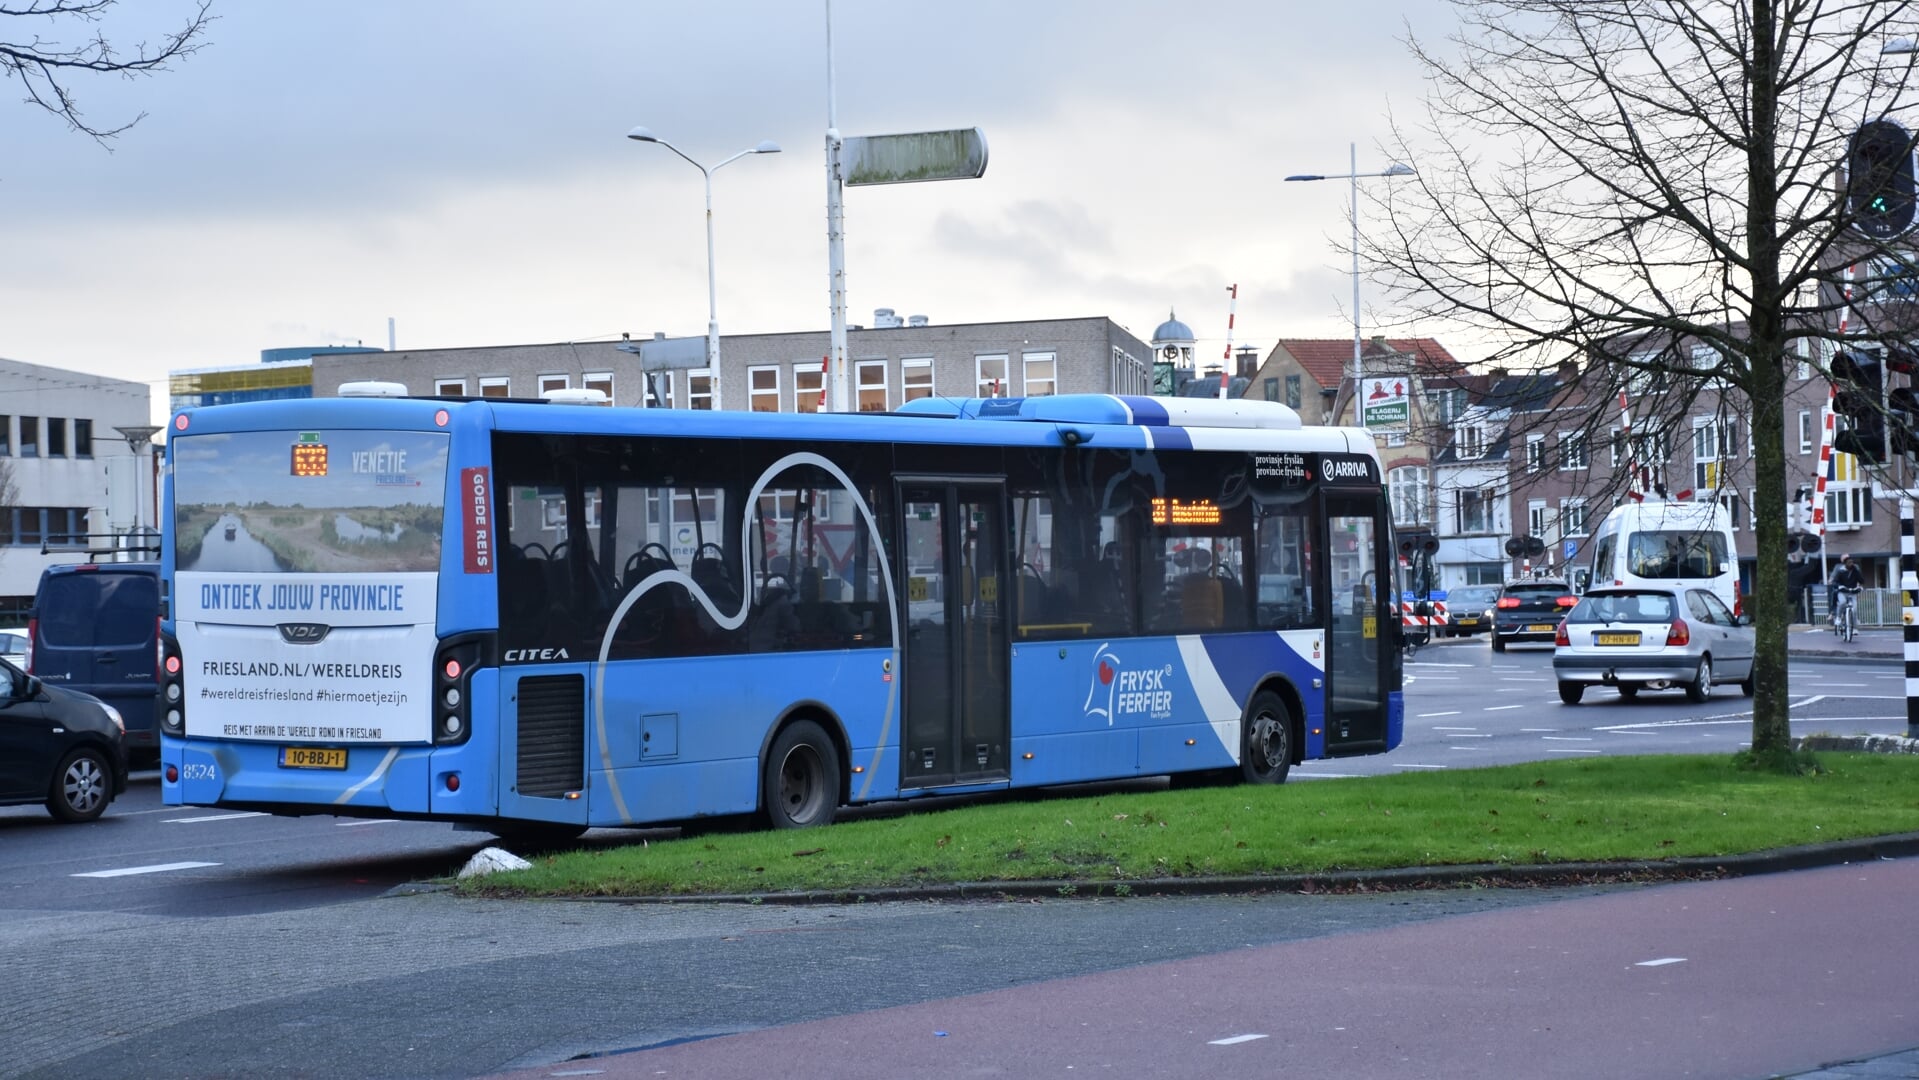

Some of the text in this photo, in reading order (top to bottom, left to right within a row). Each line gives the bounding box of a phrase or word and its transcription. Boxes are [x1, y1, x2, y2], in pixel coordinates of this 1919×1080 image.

[1371, 407, 1401, 415] SLAGERIJ
[1376, 413, 1406, 421] SCHRANS
[352, 449, 407, 473] VENETIË
[1256, 455, 1304, 466] provinsje fryslân
[1256, 466, 1305, 479] provincie fryslân
[1335, 462, 1368, 477] ARRIVA
[473, 474, 488, 567] GOEDE REIS
[201, 584, 404, 611] ONTDEK JOUW PROVINCIE
[285, 626, 319, 638] VDL
[504, 648, 569, 661] CITEA
[203, 661, 402, 678] FRIESLAND.NL/WERELDREIS
[1119, 669, 1164, 692] FRYSK
[201, 688, 408, 706] #wereldreisfriesland #hiermoetjezijn
[1118, 690, 1172, 714] FERFIER
[224, 724, 238, 735] REIS
[239, 725, 253, 735] MET
[254, 725, 276, 736] ARRIVA
[277, 726, 286, 737] DE
[319, 727, 335, 738] ROND
[337, 728, 344, 738] IN
[346, 728, 382, 739] FRIESLAND
[292, 750, 339, 766] 10-BBJ-1
[183, 764, 215, 780] 8524
